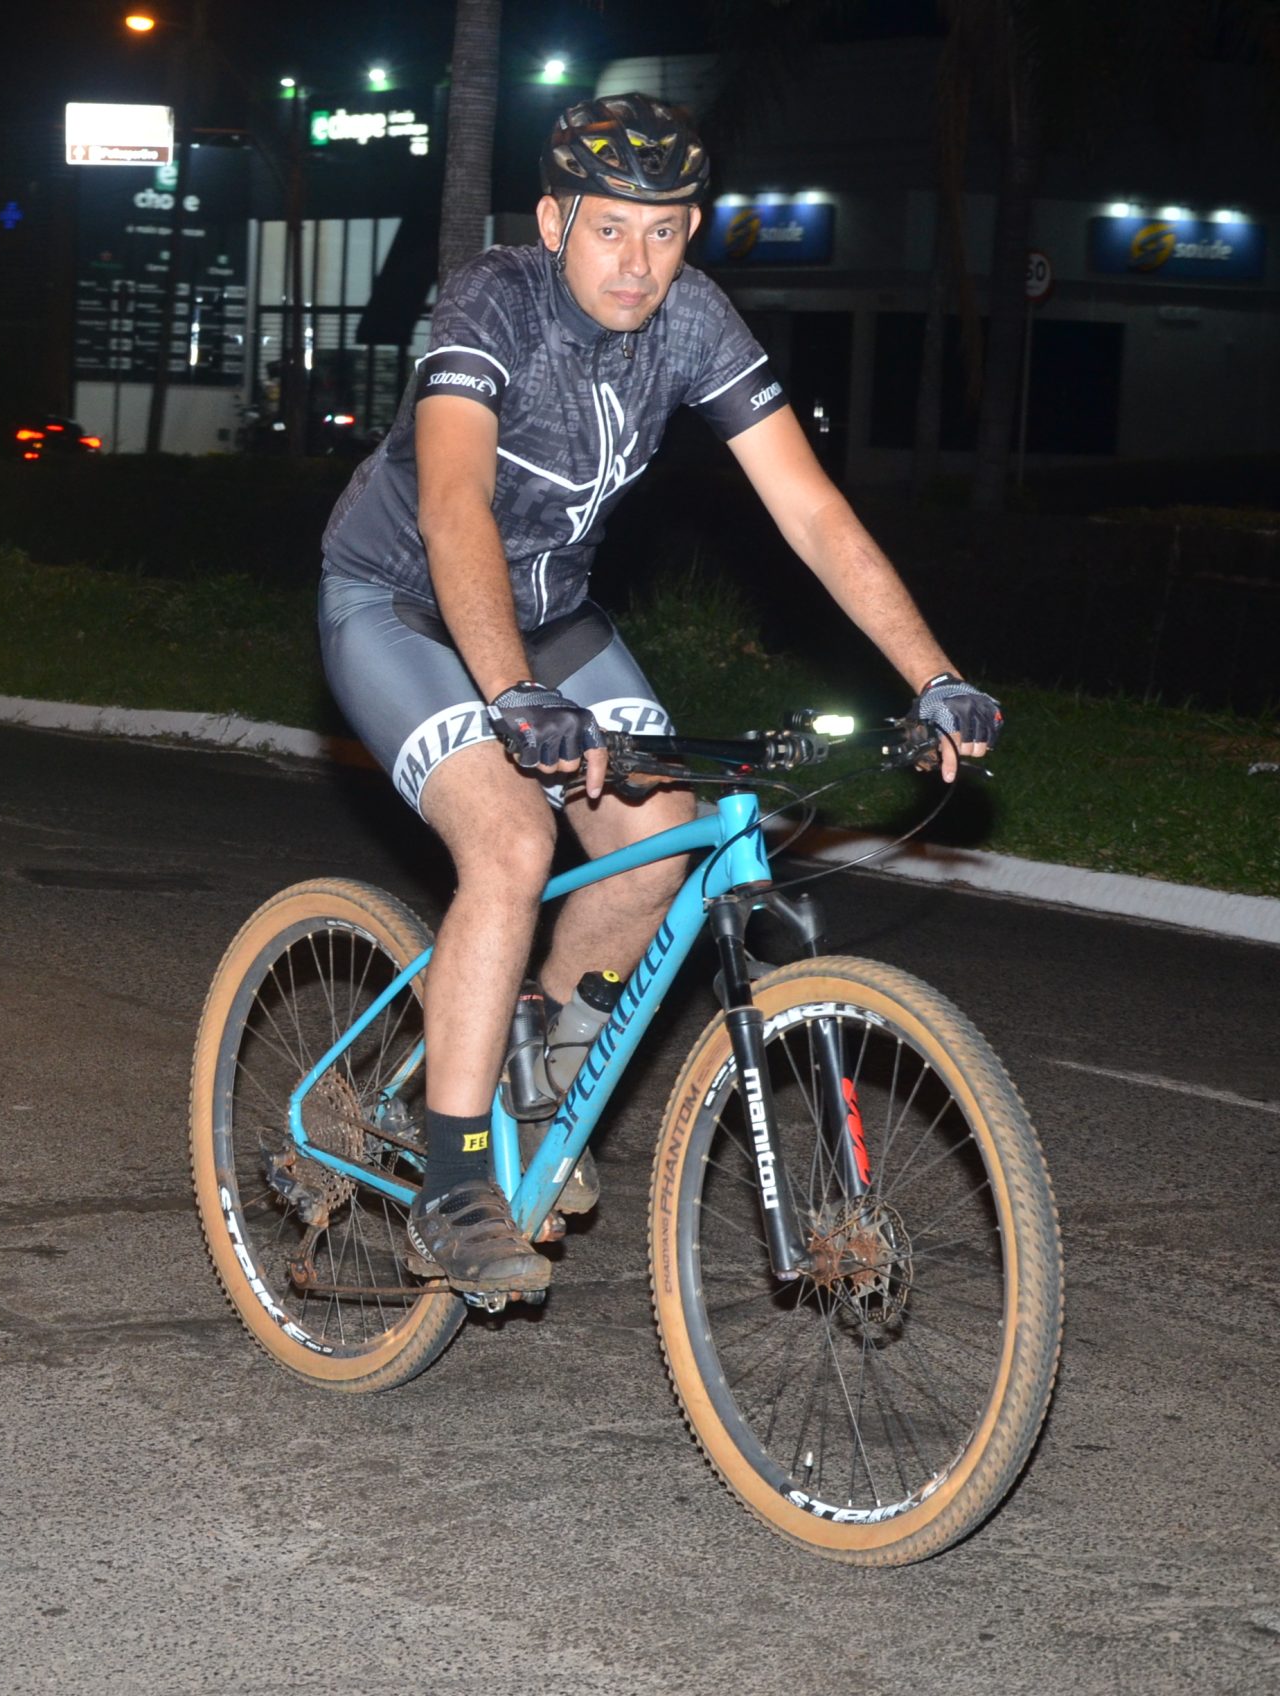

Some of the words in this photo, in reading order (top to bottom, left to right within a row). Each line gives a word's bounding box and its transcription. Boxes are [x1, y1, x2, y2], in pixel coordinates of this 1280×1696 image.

[134, 189, 200, 211] choe
[552, 914, 676, 1146] SPECIALIZED
[659, 1081, 701, 1217] PHANTOM
[743, 1067, 777, 1210] manitou
